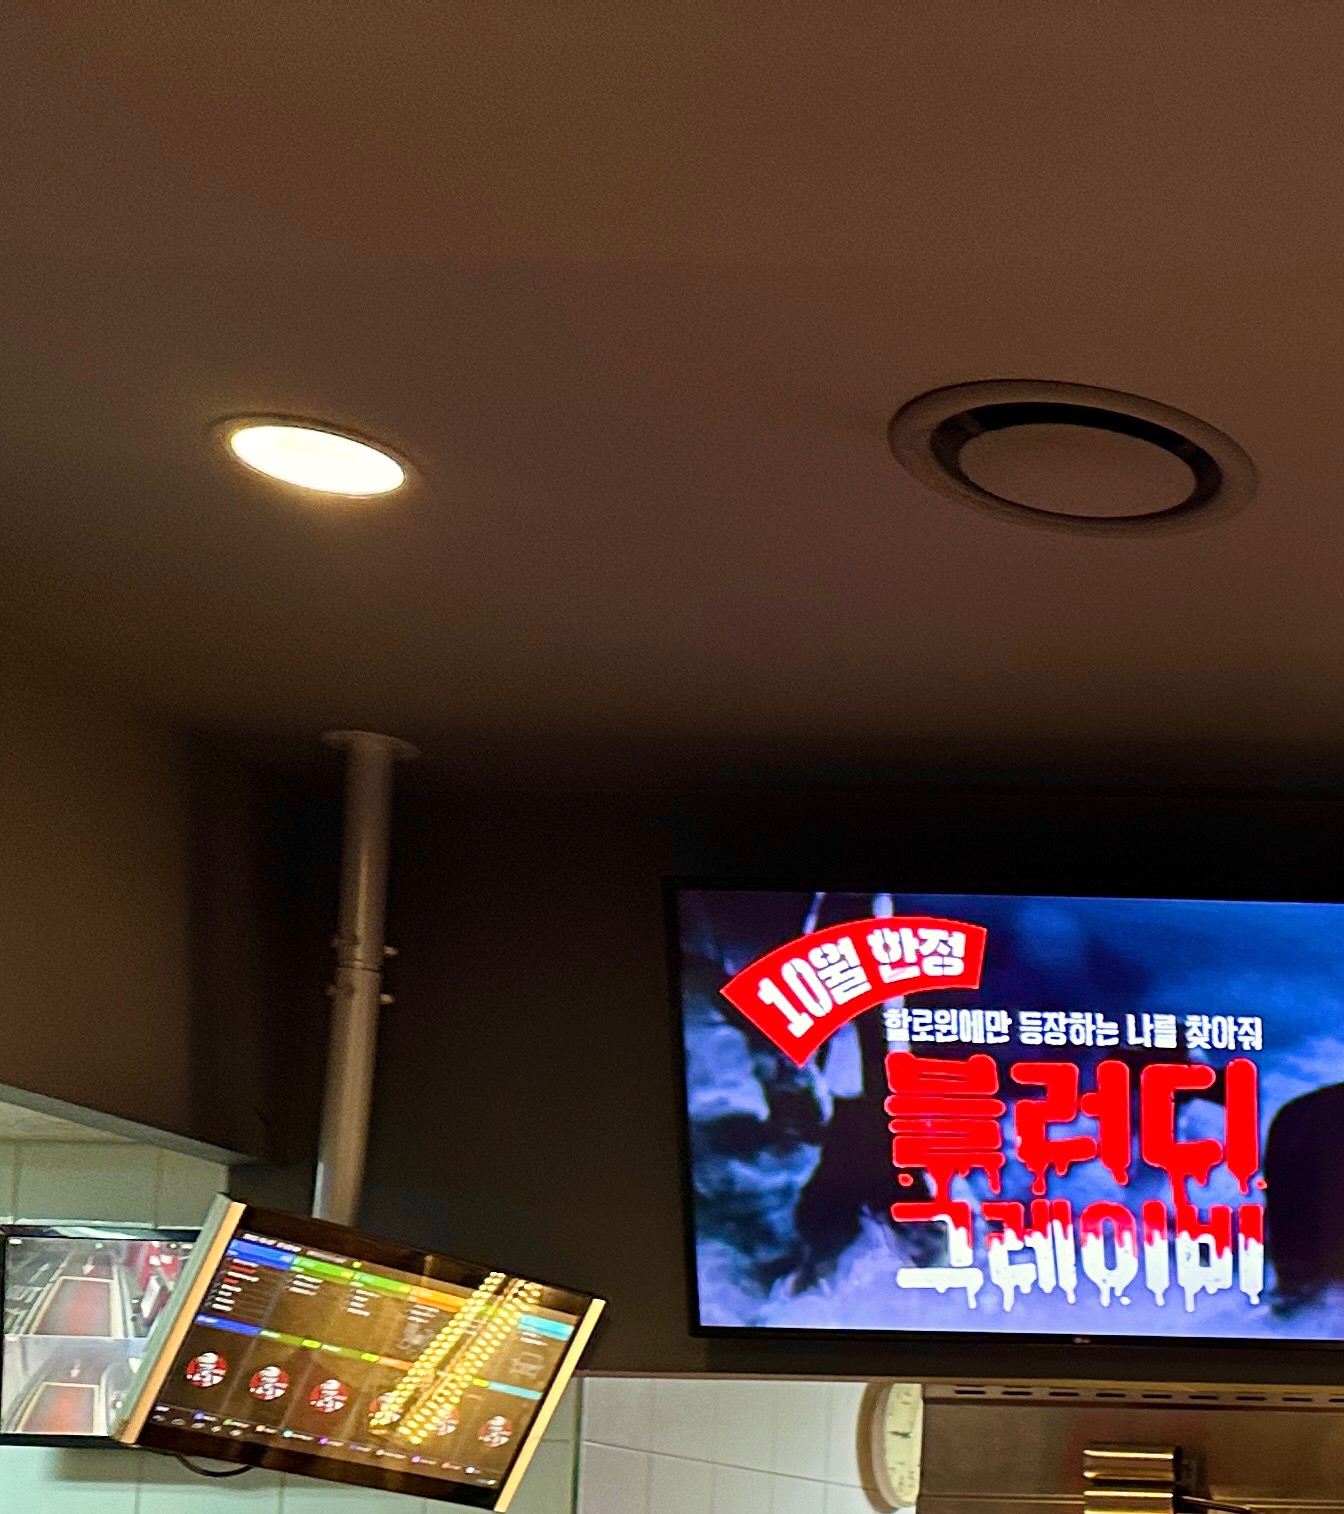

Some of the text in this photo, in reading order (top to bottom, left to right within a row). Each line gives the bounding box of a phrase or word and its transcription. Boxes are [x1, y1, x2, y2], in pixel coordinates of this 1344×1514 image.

[756, 928, 966, 1041] 10월 한정
[883, 1007, 1263, 1052] 할로윈에만 등장하는 나를 찾아줘
[884, 1052, 1268, 1196] 블러디
[889, 1198, 1267, 1313] 그레이비
